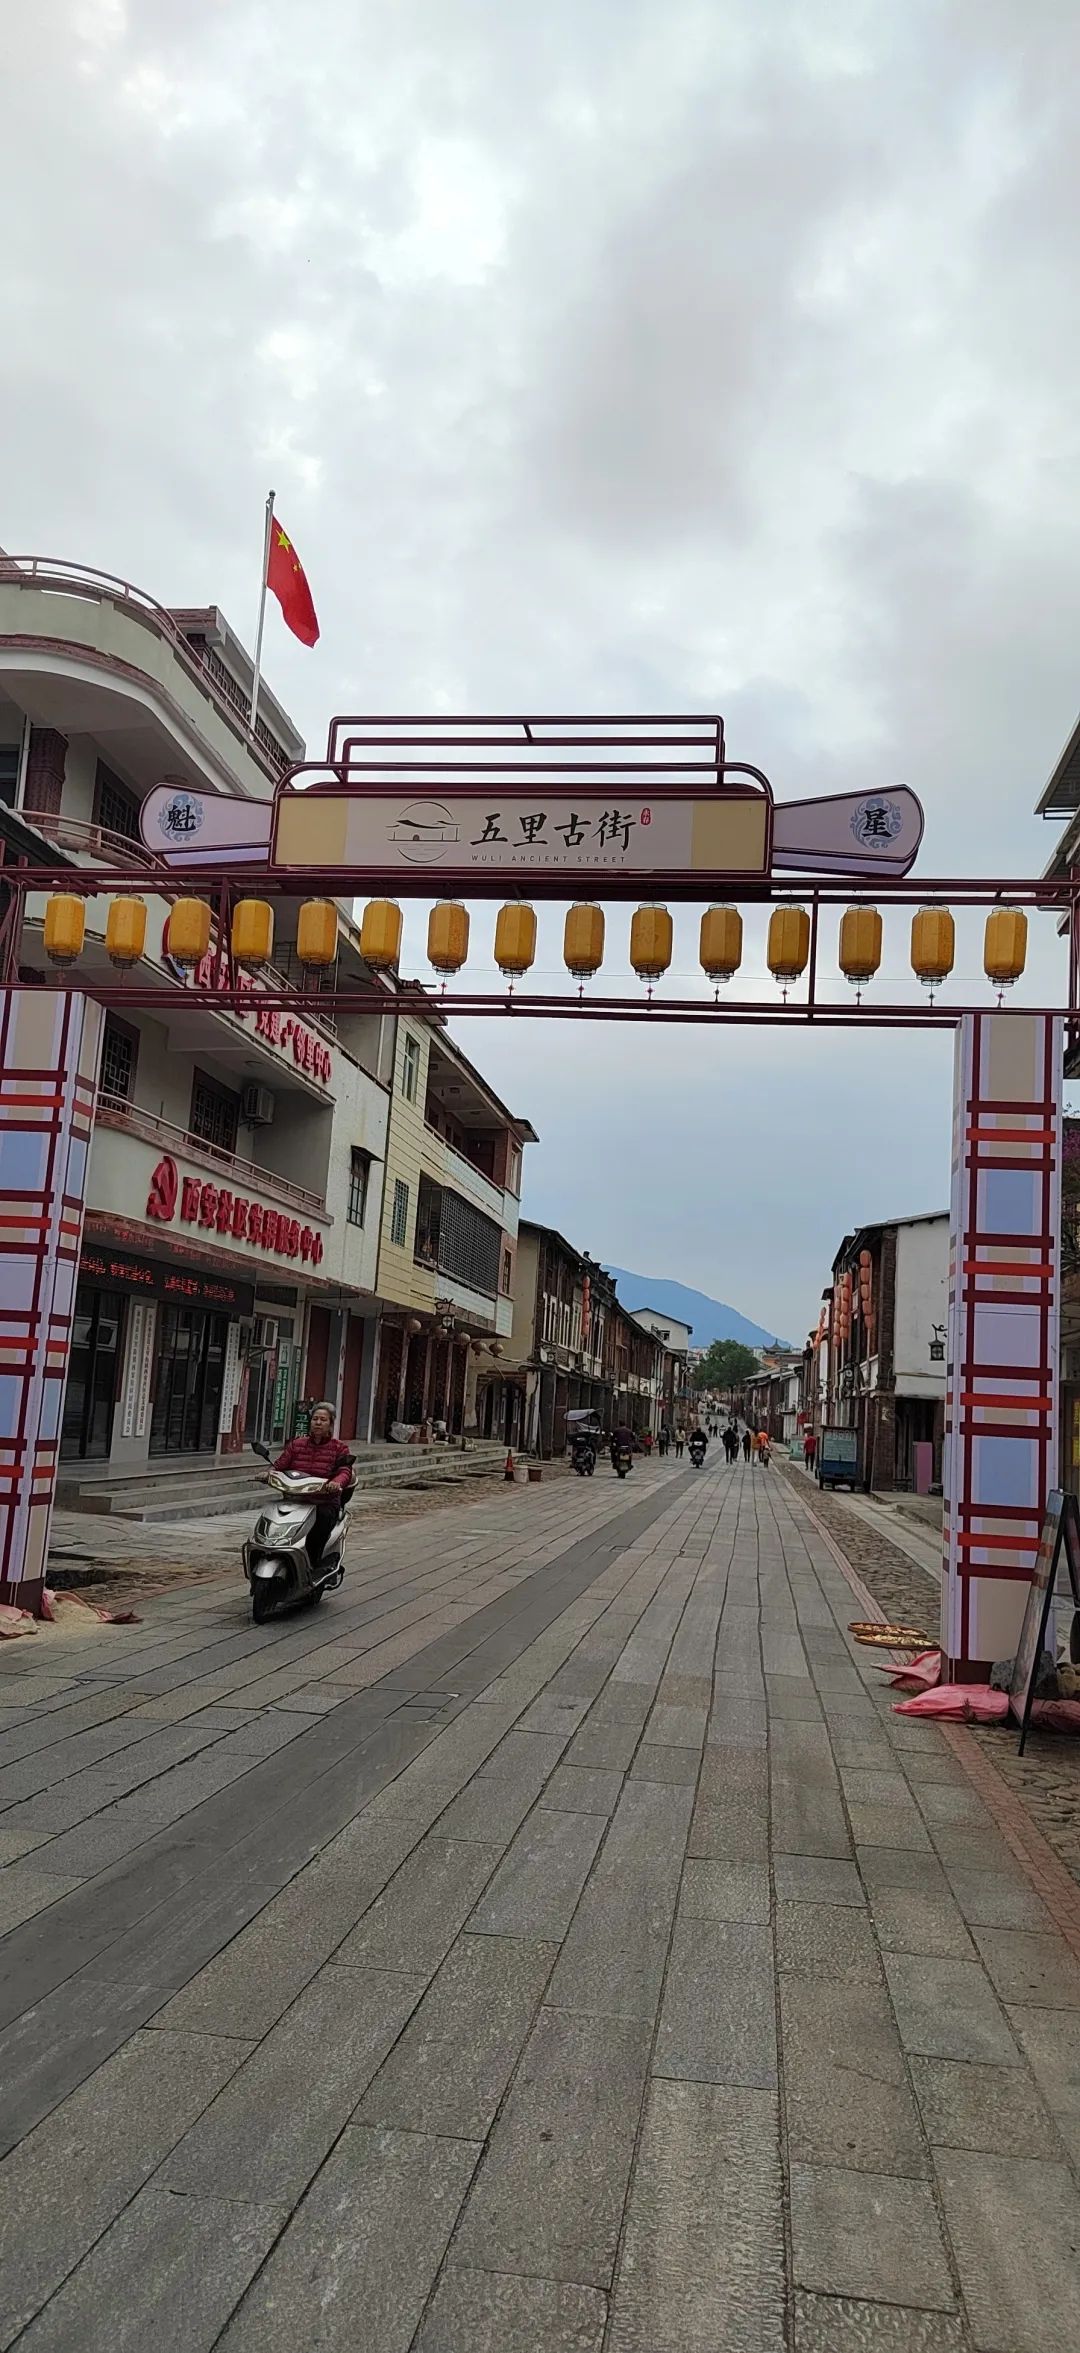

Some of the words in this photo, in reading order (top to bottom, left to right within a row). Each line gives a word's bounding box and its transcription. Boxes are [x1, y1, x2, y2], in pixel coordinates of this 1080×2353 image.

[166, 805, 196, 831] 魁
[470, 810, 637, 852] 五里古街
[861, 808, 892, 837] 星
[512, 855, 568, 863] ANCIENT
